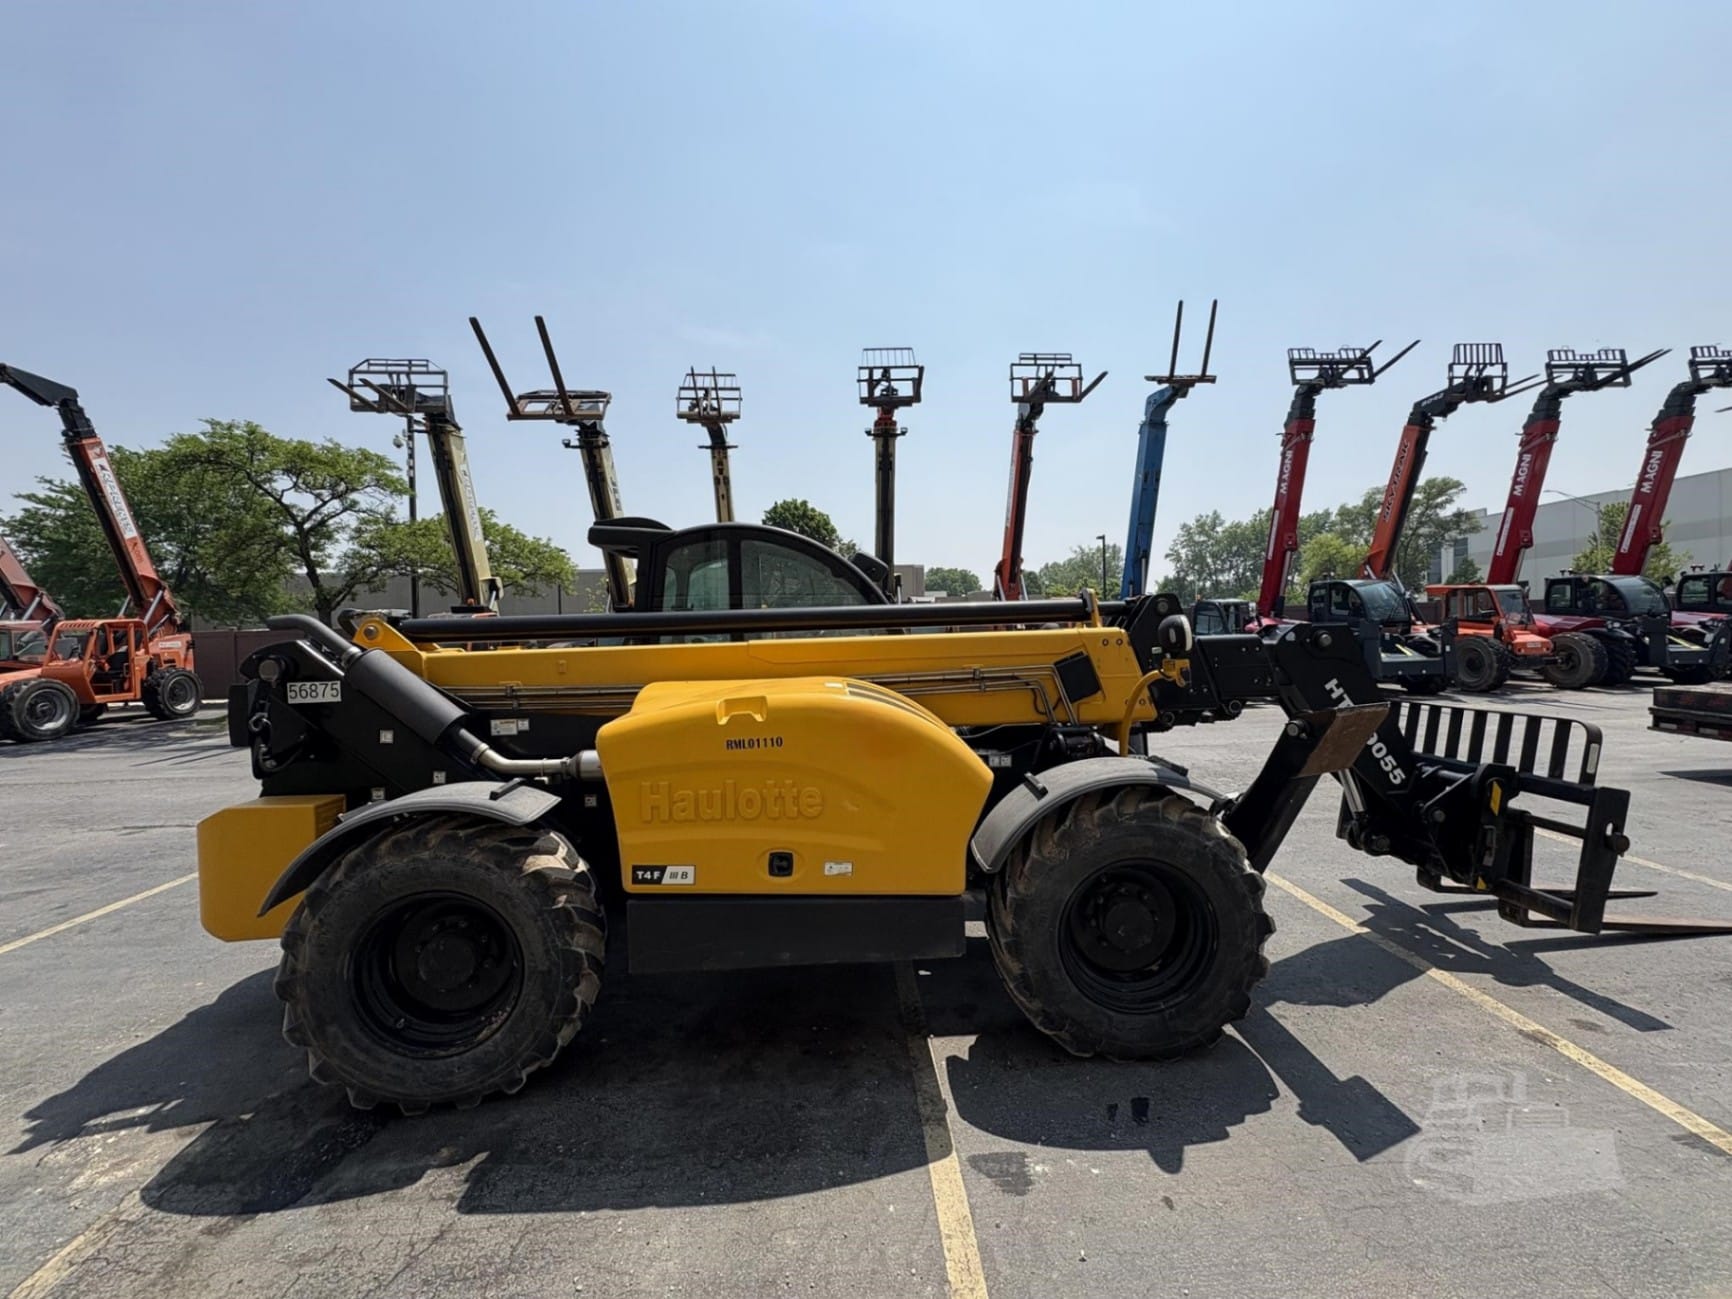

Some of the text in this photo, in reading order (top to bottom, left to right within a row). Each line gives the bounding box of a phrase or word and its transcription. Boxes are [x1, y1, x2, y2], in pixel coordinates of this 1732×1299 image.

[1280, 450, 1294, 494] MAGNI
[1384, 440, 1409, 522] SKYTRAK
[1513, 454, 1532, 497] MAGNI
[1640, 450, 1664, 493] MAGNI
[288, 682, 340, 700] 56875
[726, 736, 783, 750] RML01110
[640, 779, 823, 822] Haulotte
